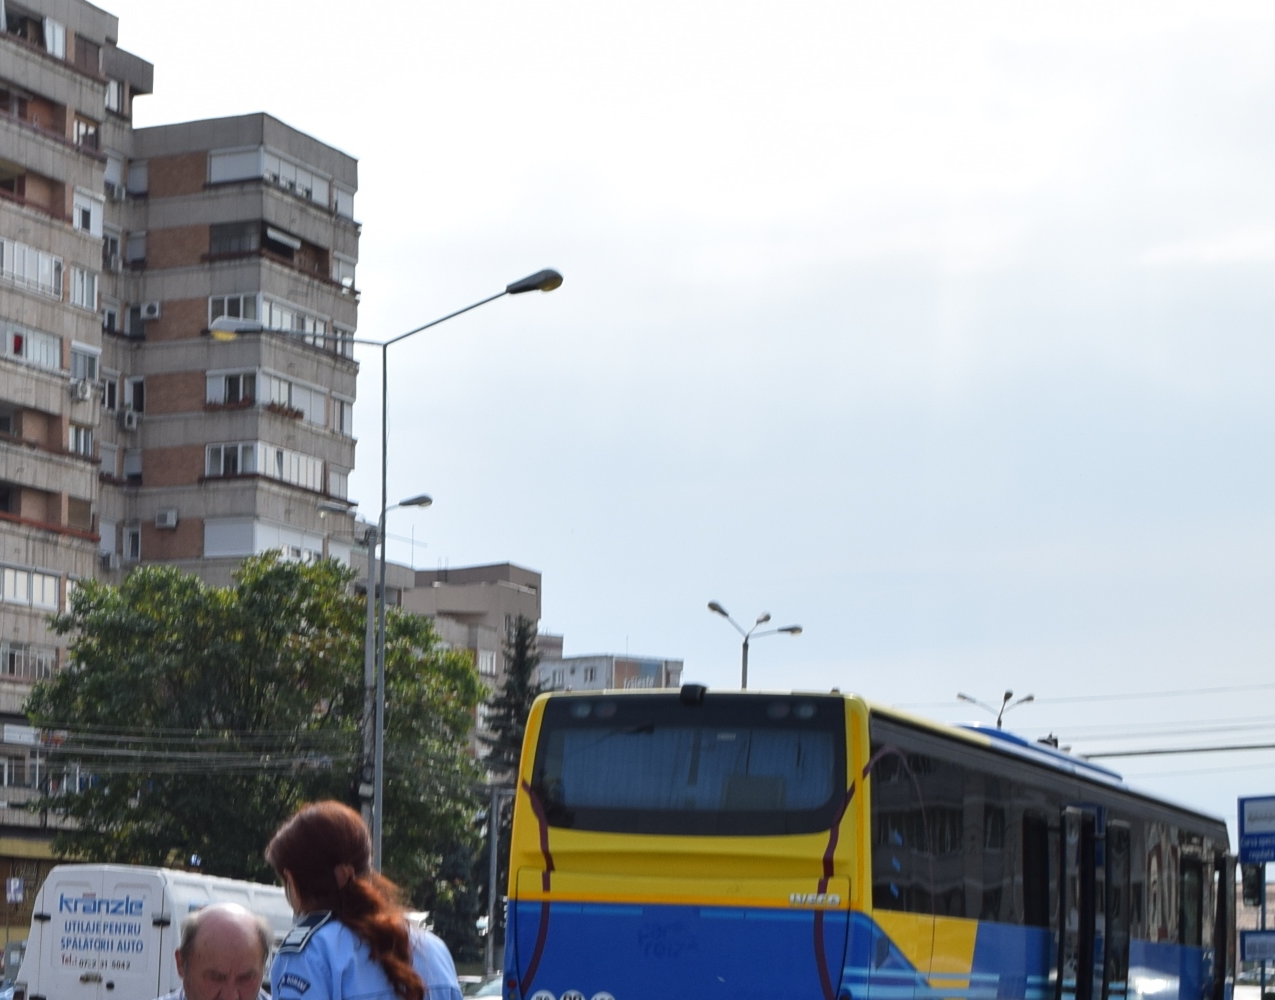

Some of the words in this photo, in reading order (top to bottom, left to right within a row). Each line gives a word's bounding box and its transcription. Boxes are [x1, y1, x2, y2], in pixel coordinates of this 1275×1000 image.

[789, 892, 841, 907] IVECO
[64, 920, 100, 935] UTILAJE
[103, 922, 141, 936] PENTRU
[117, 940, 144, 954] AUTO
